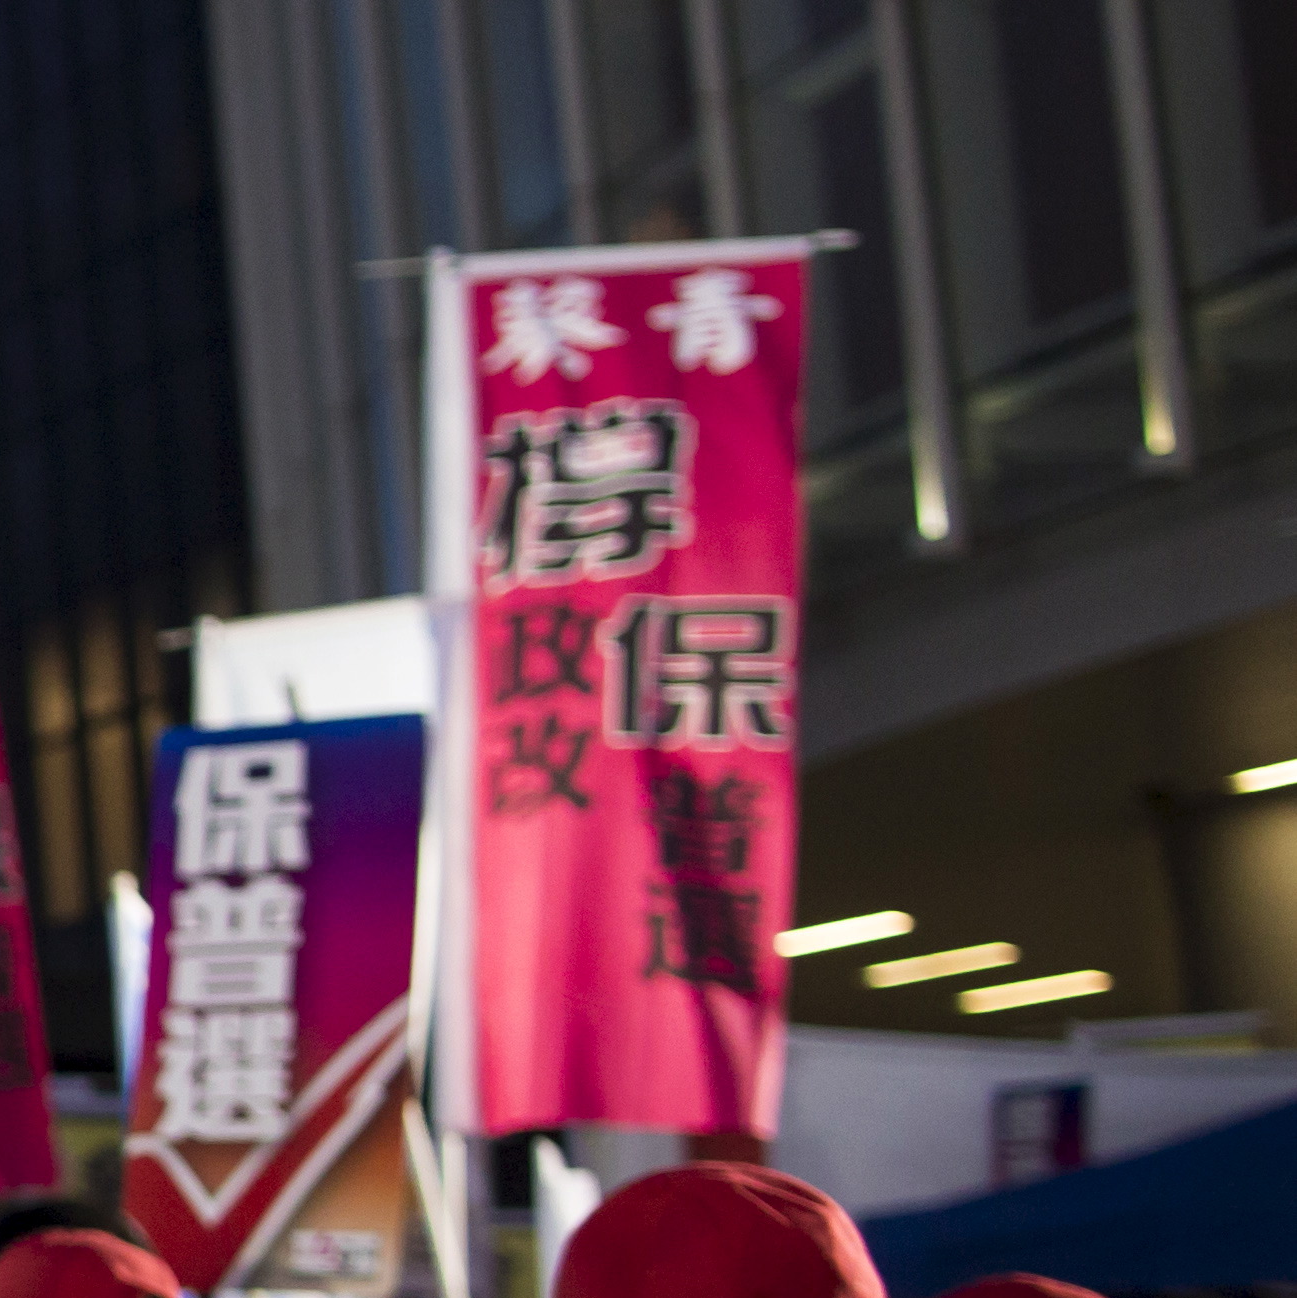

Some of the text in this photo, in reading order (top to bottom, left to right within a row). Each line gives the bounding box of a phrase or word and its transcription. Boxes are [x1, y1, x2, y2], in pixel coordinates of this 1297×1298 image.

[483, 268, 783, 378] 葵青
[153, 736, 312, 1145] 保普選
